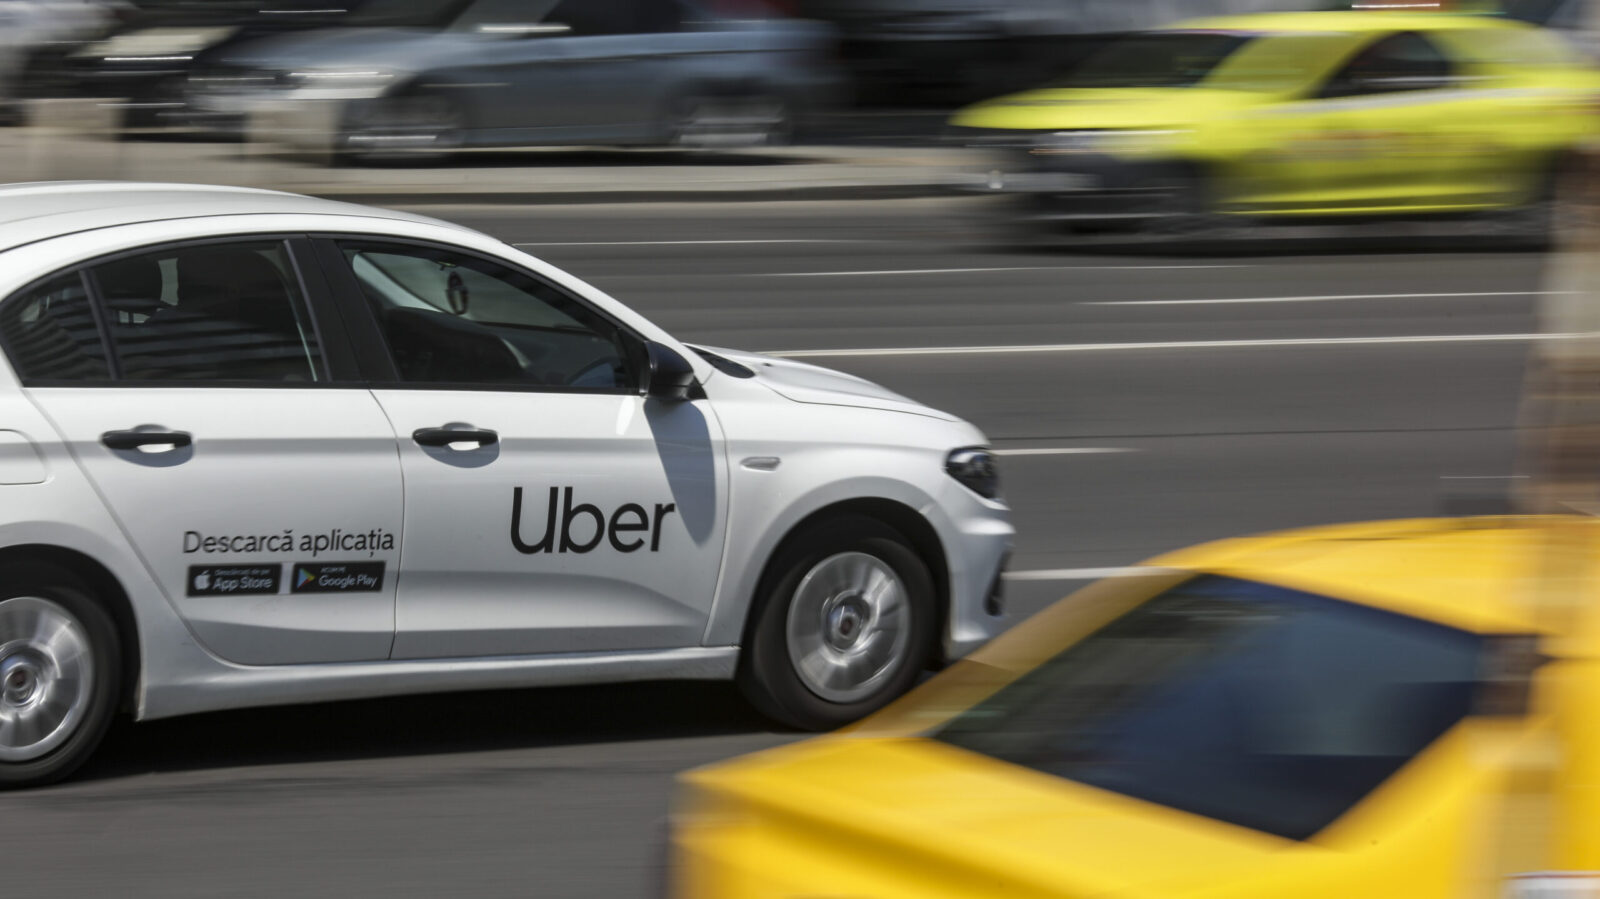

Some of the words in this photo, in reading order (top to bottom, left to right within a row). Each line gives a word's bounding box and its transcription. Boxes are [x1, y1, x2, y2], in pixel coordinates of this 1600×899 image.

[511, 486, 675, 554] Uber
[183, 529, 293, 553] Descarcă
[299, 528, 394, 557] aplicația
[212, 576, 239, 592] App
[239, 576, 273, 589] Store
[318, 574, 356, 589] Google
[356, 573, 378, 588] Play
